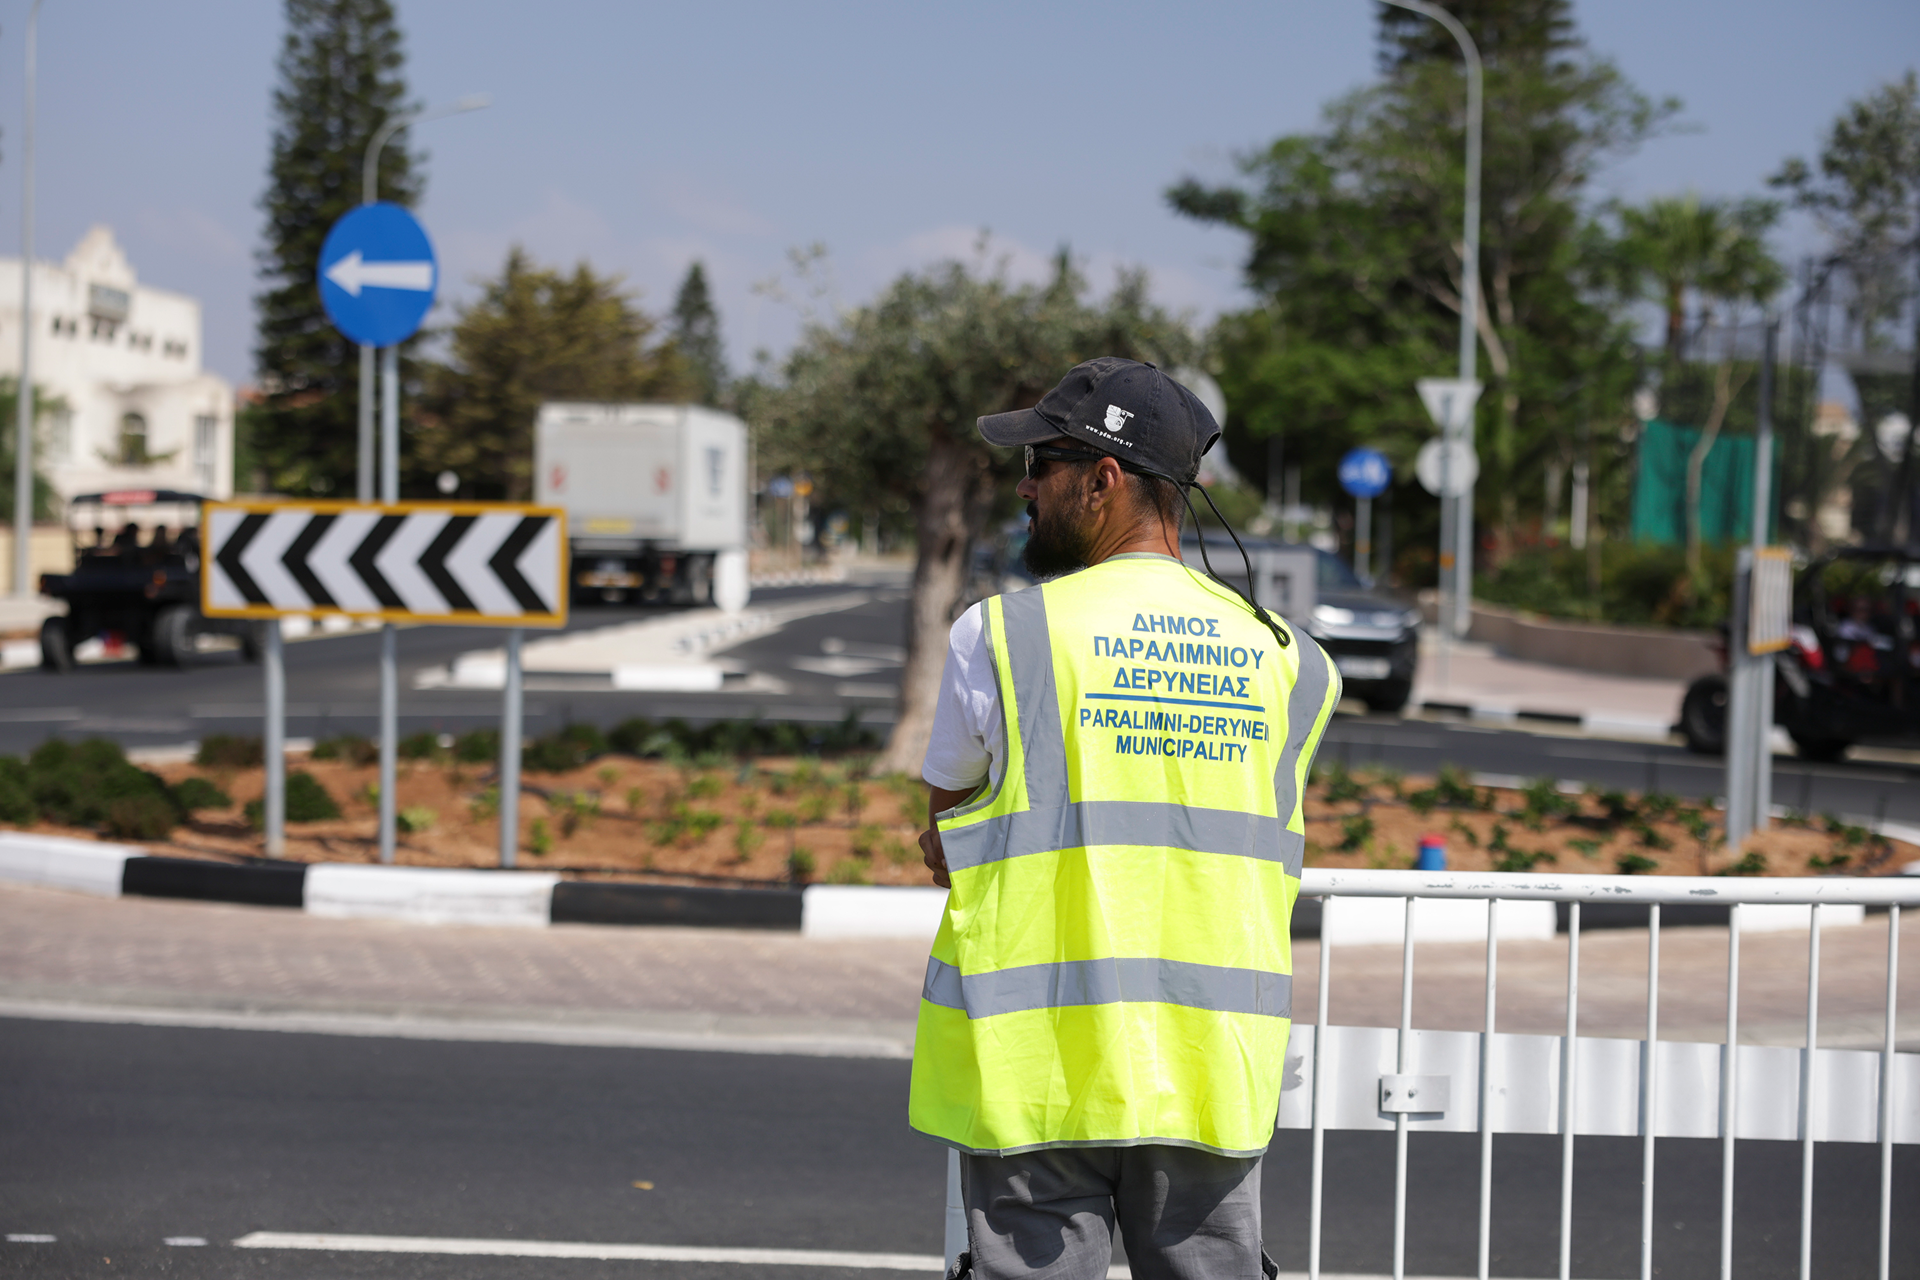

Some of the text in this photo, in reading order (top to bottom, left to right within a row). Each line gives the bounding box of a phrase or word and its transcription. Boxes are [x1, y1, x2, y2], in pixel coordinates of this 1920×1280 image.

[1132, 613, 1221, 638] ΔΗΜΟΣ
[1094, 636, 1264, 669] ΠΑΡΑΛΙΜΝΙΟΥ
[1113, 667, 1250, 698] ΔΕΡΥΝΕΙΑΣ
[1116, 735, 1247, 762] MUNICIPALITY
